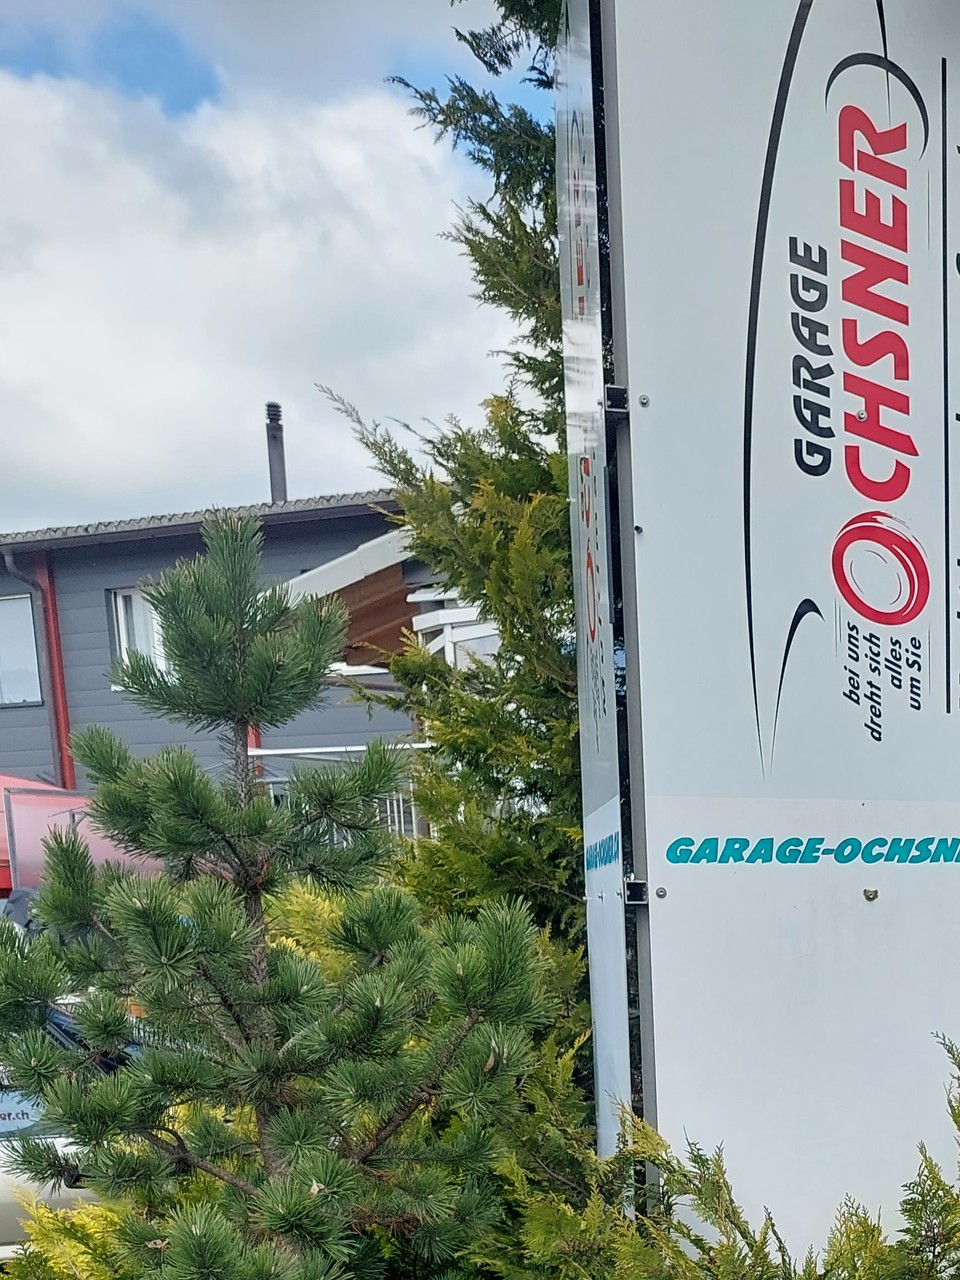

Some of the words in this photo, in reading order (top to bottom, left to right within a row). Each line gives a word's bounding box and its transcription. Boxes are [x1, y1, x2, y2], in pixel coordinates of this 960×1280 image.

[788, 236, 833, 477] GARAGE
[847, 620, 860, 663] uns
[862, 632, 881, 677] sich
[884, 636, 902, 690] alles
[904, 636, 922, 673] Sie
[842, 665, 860, 706] bei
[909, 676, 922, 711] um
[863, 680, 882, 742] dreht
